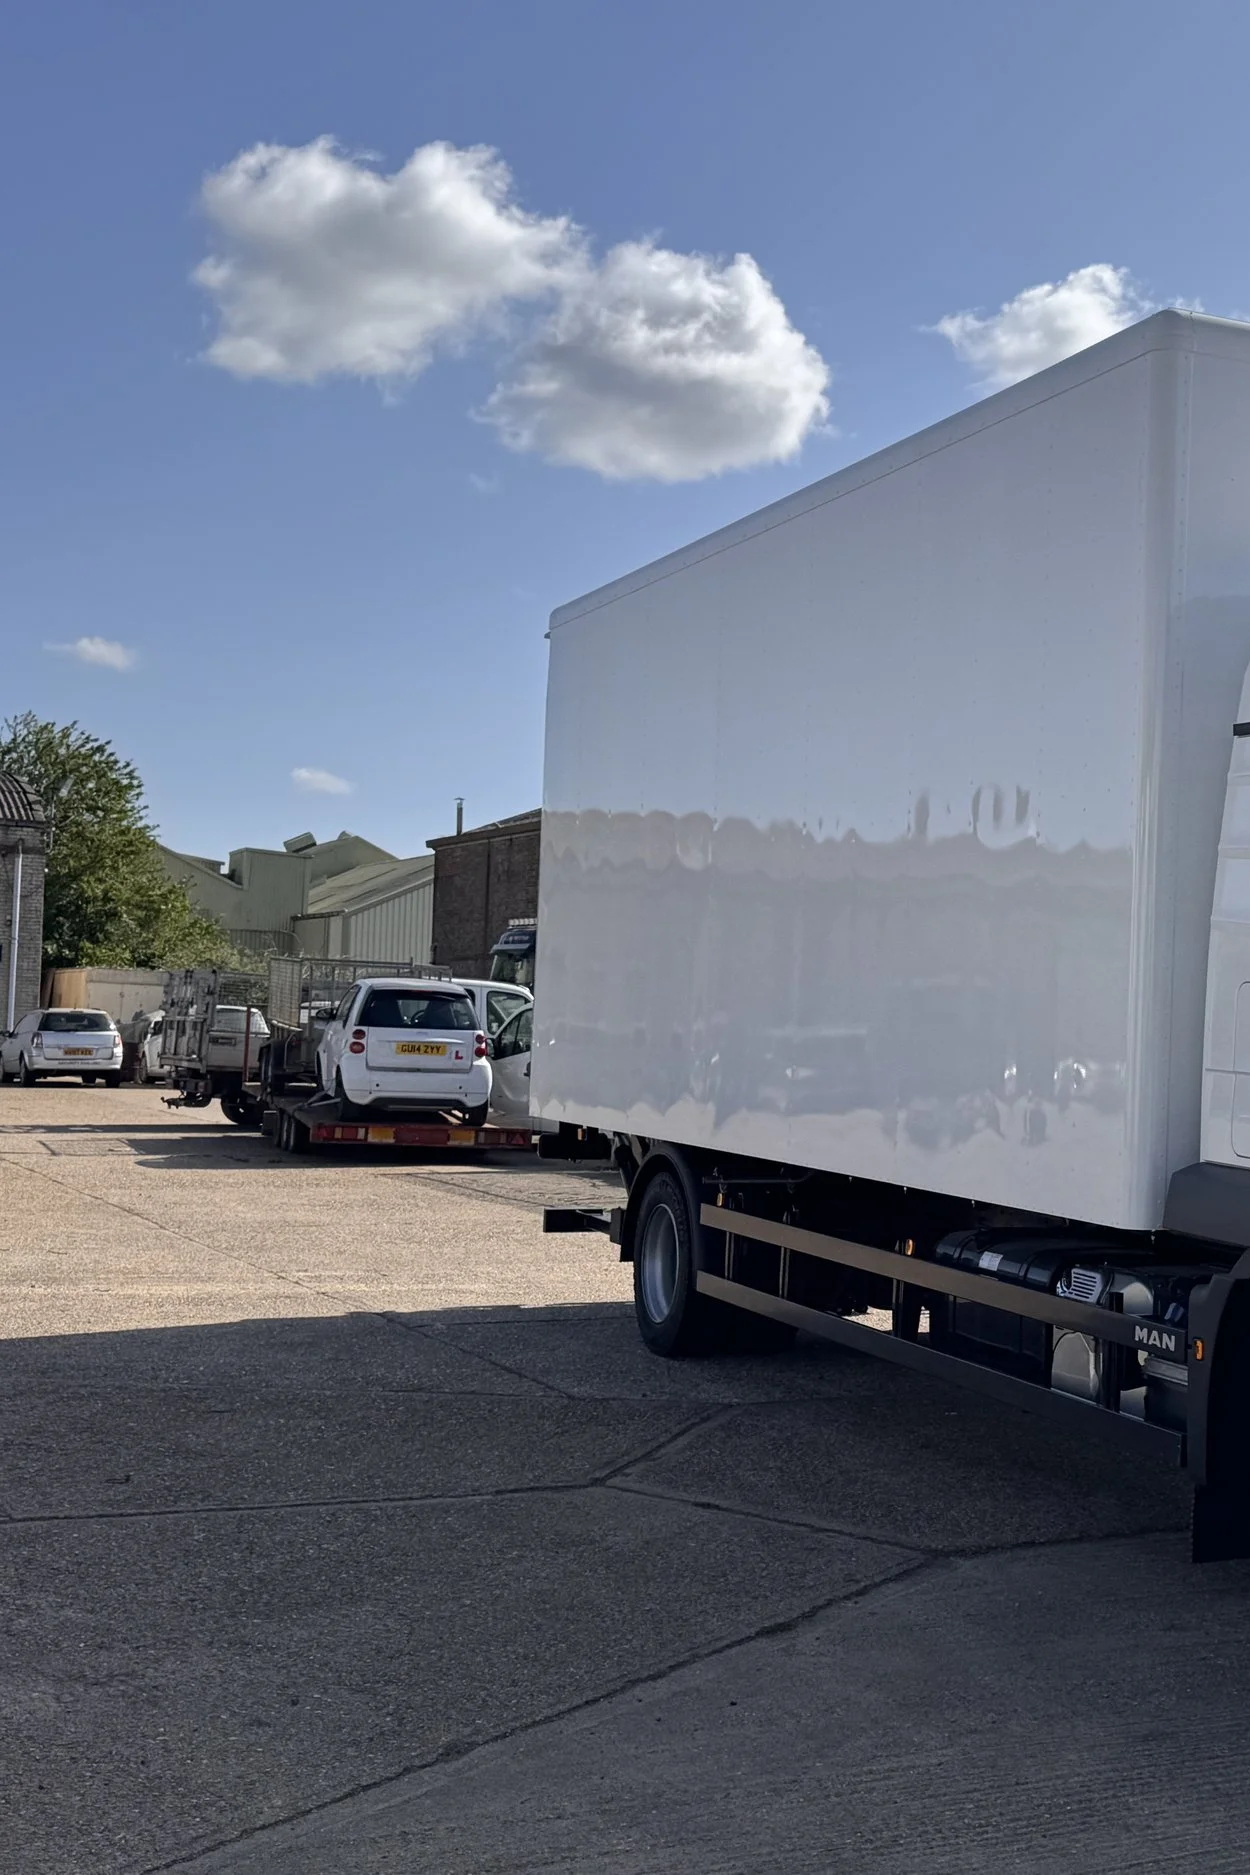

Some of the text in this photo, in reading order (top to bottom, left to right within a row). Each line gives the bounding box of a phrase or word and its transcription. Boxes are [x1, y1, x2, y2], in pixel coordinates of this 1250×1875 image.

[401, 1043, 442, 1055] GU14 ZYY
[1134, 1325, 1176, 1352] MAN
